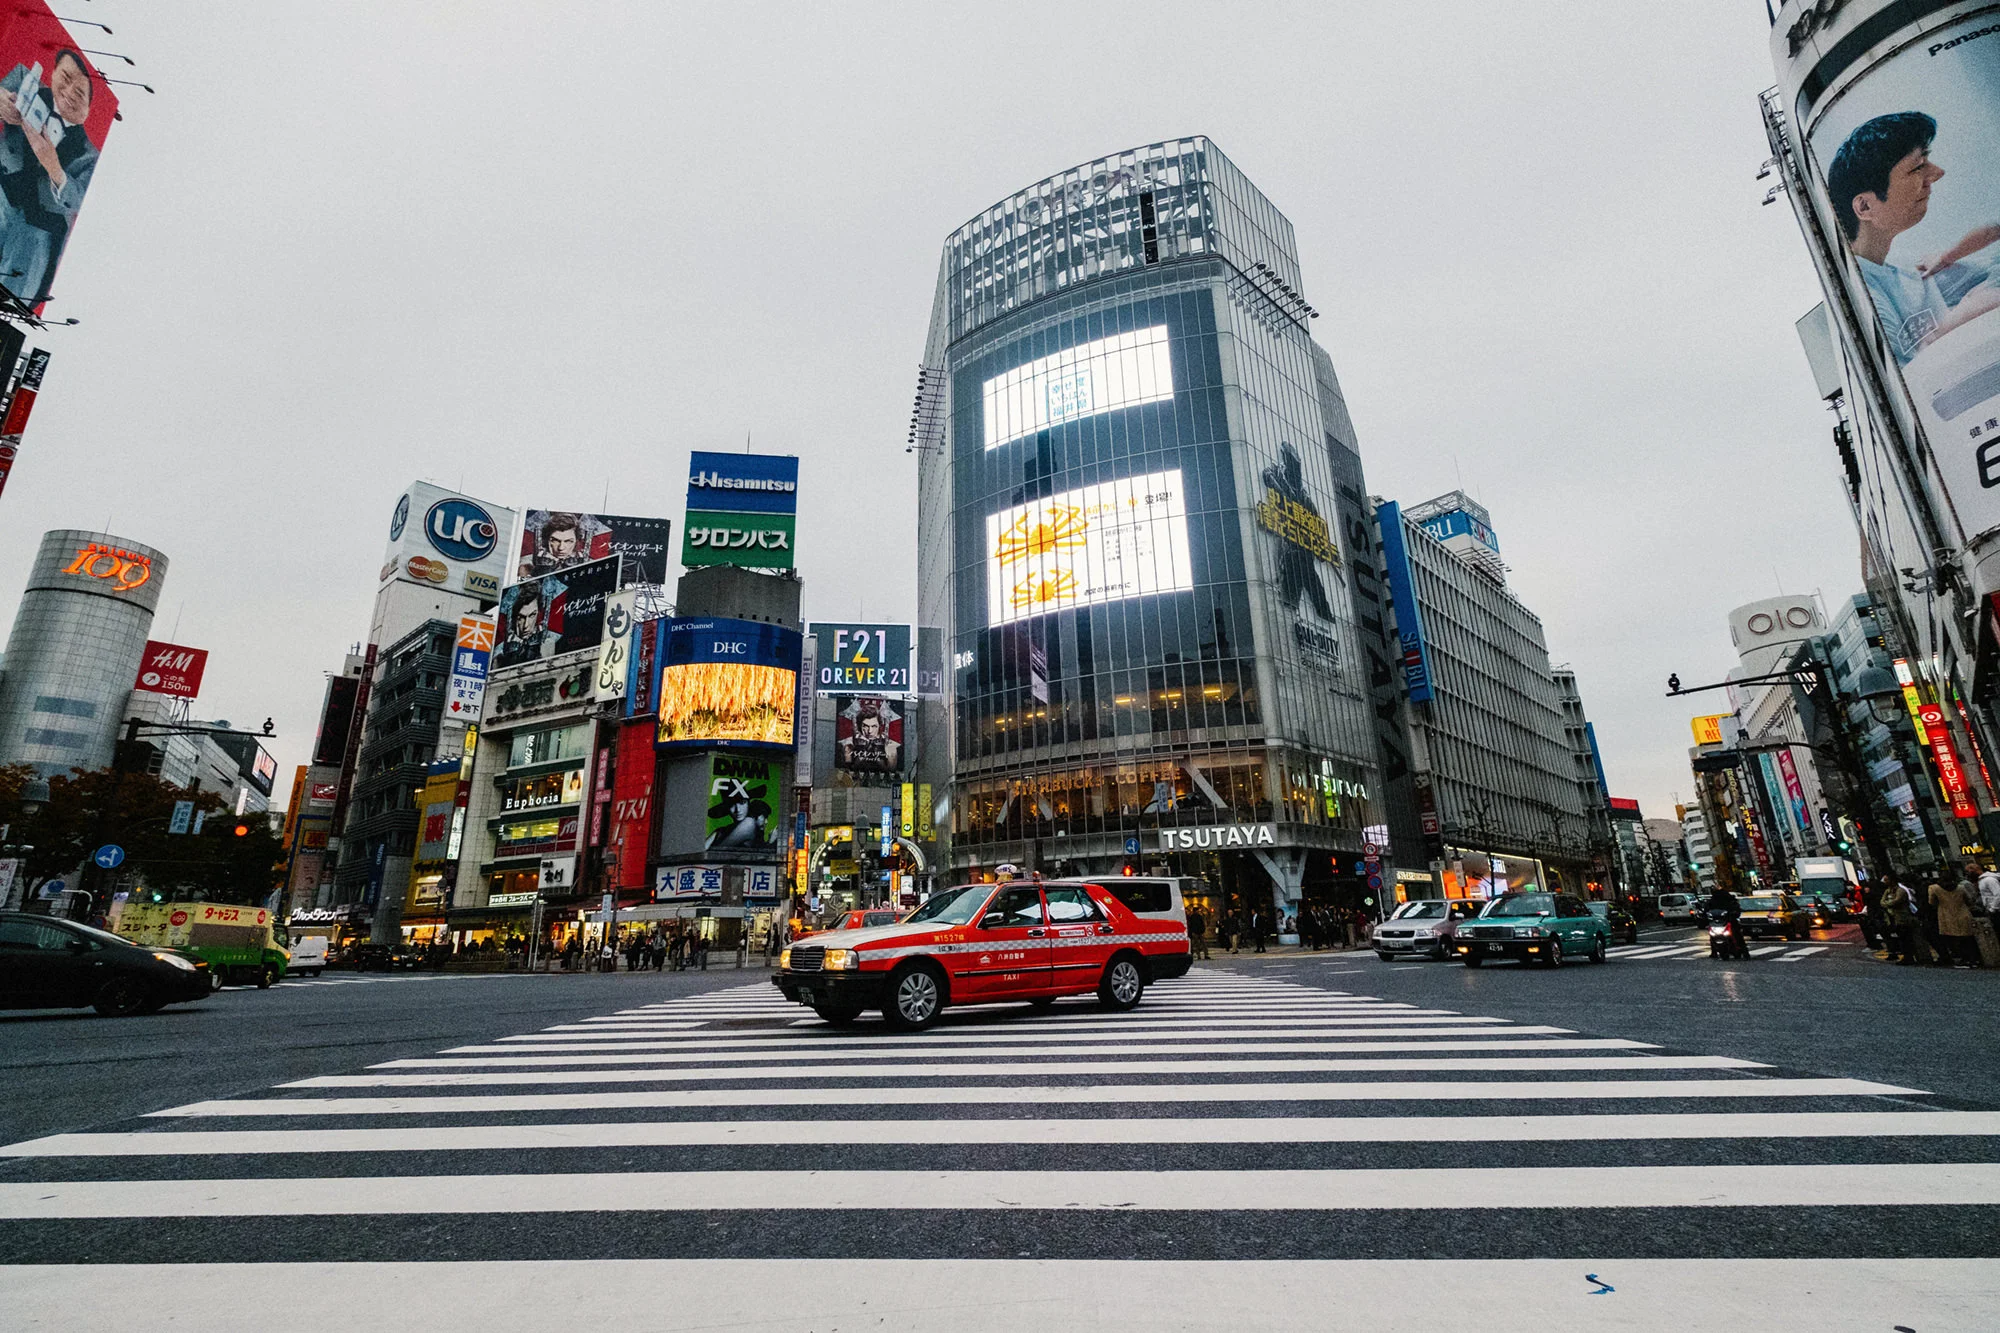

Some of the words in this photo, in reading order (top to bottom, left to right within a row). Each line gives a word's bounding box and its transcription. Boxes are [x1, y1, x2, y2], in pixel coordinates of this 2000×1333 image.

[689, 471, 796, 492] Hisamitsu
[433, 508, 492, 549] UC
[688, 526, 789, 550] サロンパス
[88, 543, 152, 566] SHIBUYA
[599, 541, 664, 554] バイオハザード
[61, 549, 151, 592] 109
[408, 561, 448, 576] MasterCard
[469, 576, 498, 591] VISA
[458, 620, 494, 650] 本
[671, 624, 686, 632] DHC
[686, 622, 714, 631] Channel
[713, 641, 747, 654] DHC
[833, 629, 886, 664] F21
[151, 648, 195, 673] H&M
[161, 681, 192, 693] 150m
[453, 678, 483, 692] 夜11時
[889, 668, 907, 685] 21
[457, 690, 477, 701] まで
[462, 704, 480, 715] 地下
[799, 704, 810, 746] neon
[712, 757, 770, 780] DMM
[1932, 735, 1969, 811] 三菱東京UFJ銀行
[711, 777, 750, 799] FX
[1012, 775, 1105, 797] STARBUCKS
[1115, 767, 1182, 785] COFFEE
[1314, 773, 1369, 800] TSUTAYA
[505, 791, 559, 810] Euphoria
[881, 811, 891, 856] 洋服の青
[1163, 825, 1274, 849] TSUTAYA
[660, 869, 771, 894] 大盛堂店
[291, 907, 335, 921] グルメタウン
[121, 922, 168, 933] スジャータ
[1003, 973, 1020, 981] TAXI
